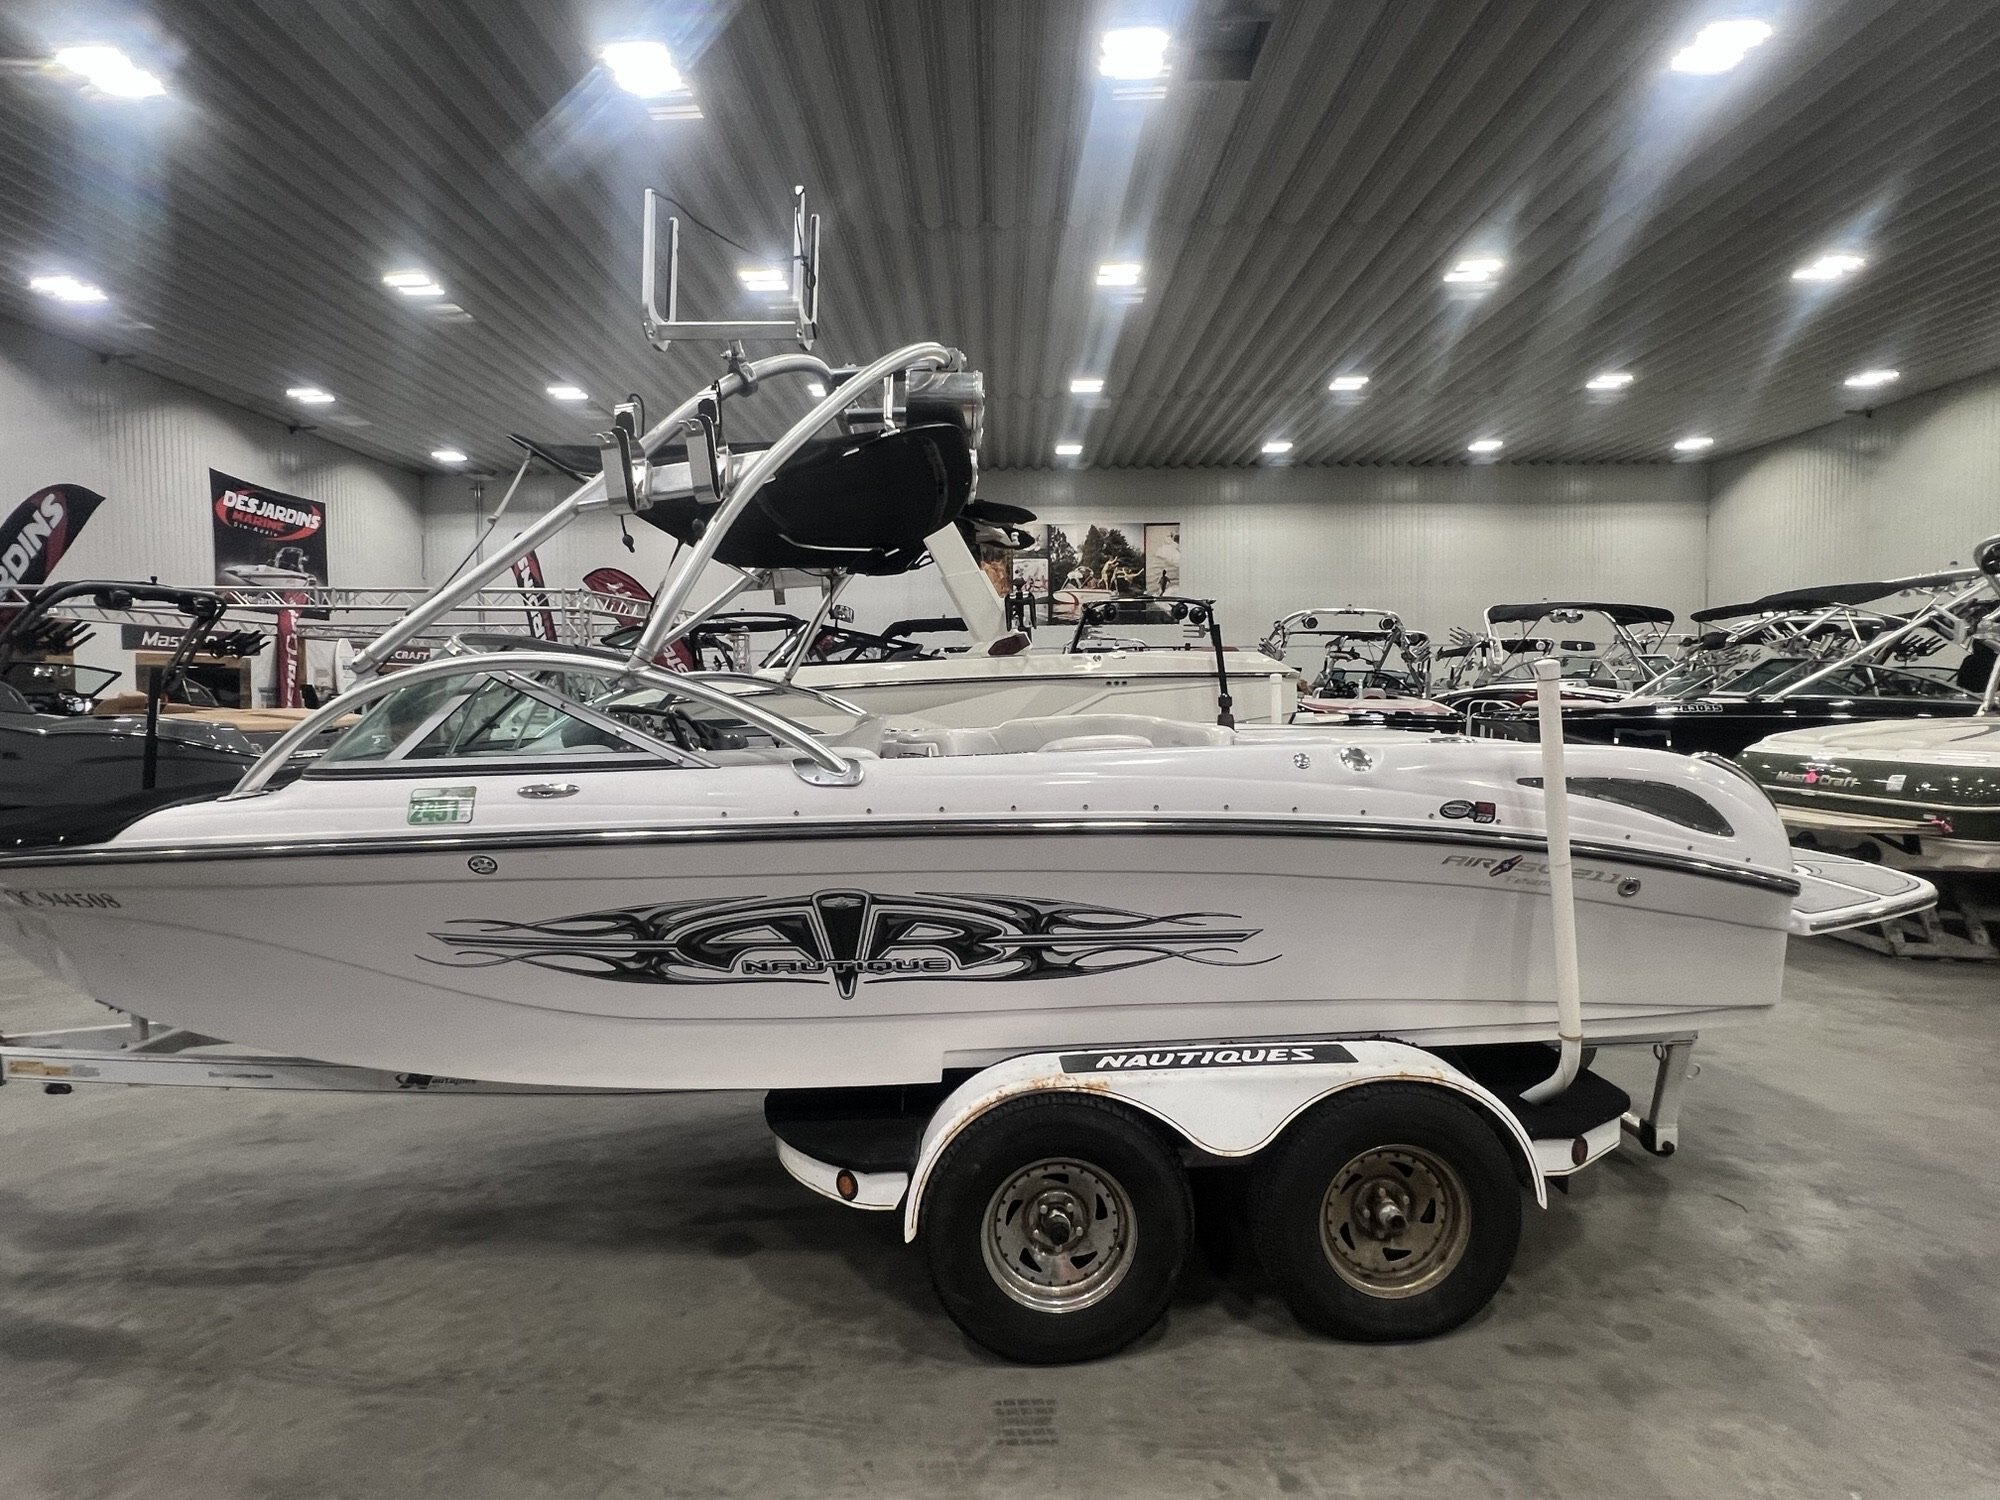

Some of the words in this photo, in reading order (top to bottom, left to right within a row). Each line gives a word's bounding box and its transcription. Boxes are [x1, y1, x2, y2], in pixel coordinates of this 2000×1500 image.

[223, 490, 321, 530] DESJARDINS
[232, 510, 287, 532] MARINE
[1442, 855, 1496, 869] AIR
[742, 958, 950, 974] NAUTIQUE
[1095, 1048, 1315, 1068] NAUTIQUES
